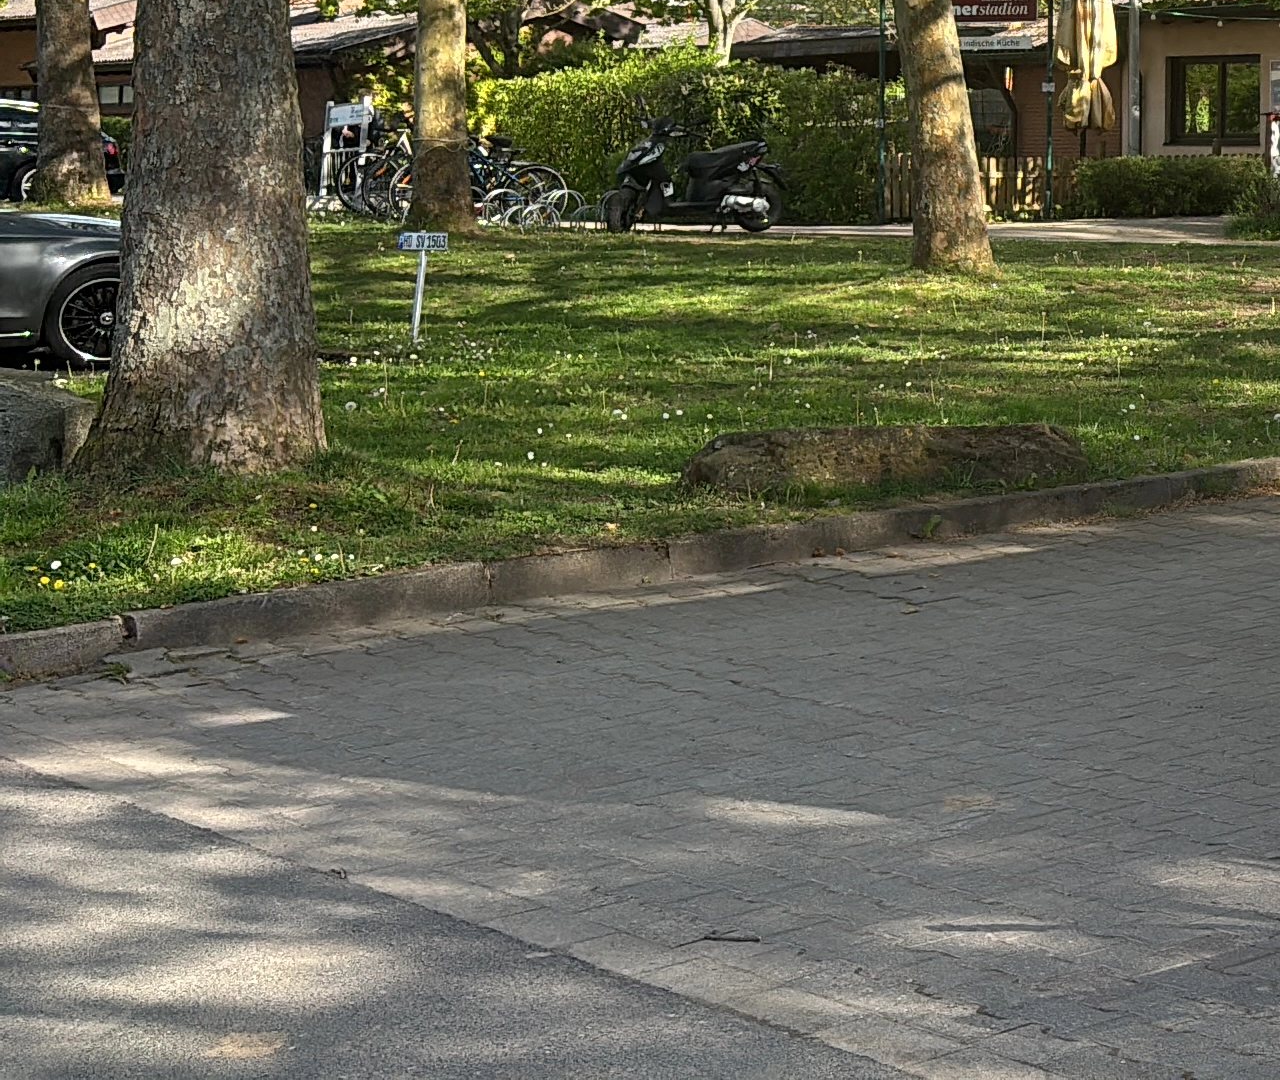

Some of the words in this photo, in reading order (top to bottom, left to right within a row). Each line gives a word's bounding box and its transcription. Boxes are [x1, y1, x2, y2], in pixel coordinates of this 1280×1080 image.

[996, 38, 1020, 47] Küche
[416, 234, 426, 248] SV
[426, 234, 446, 249] 1503
